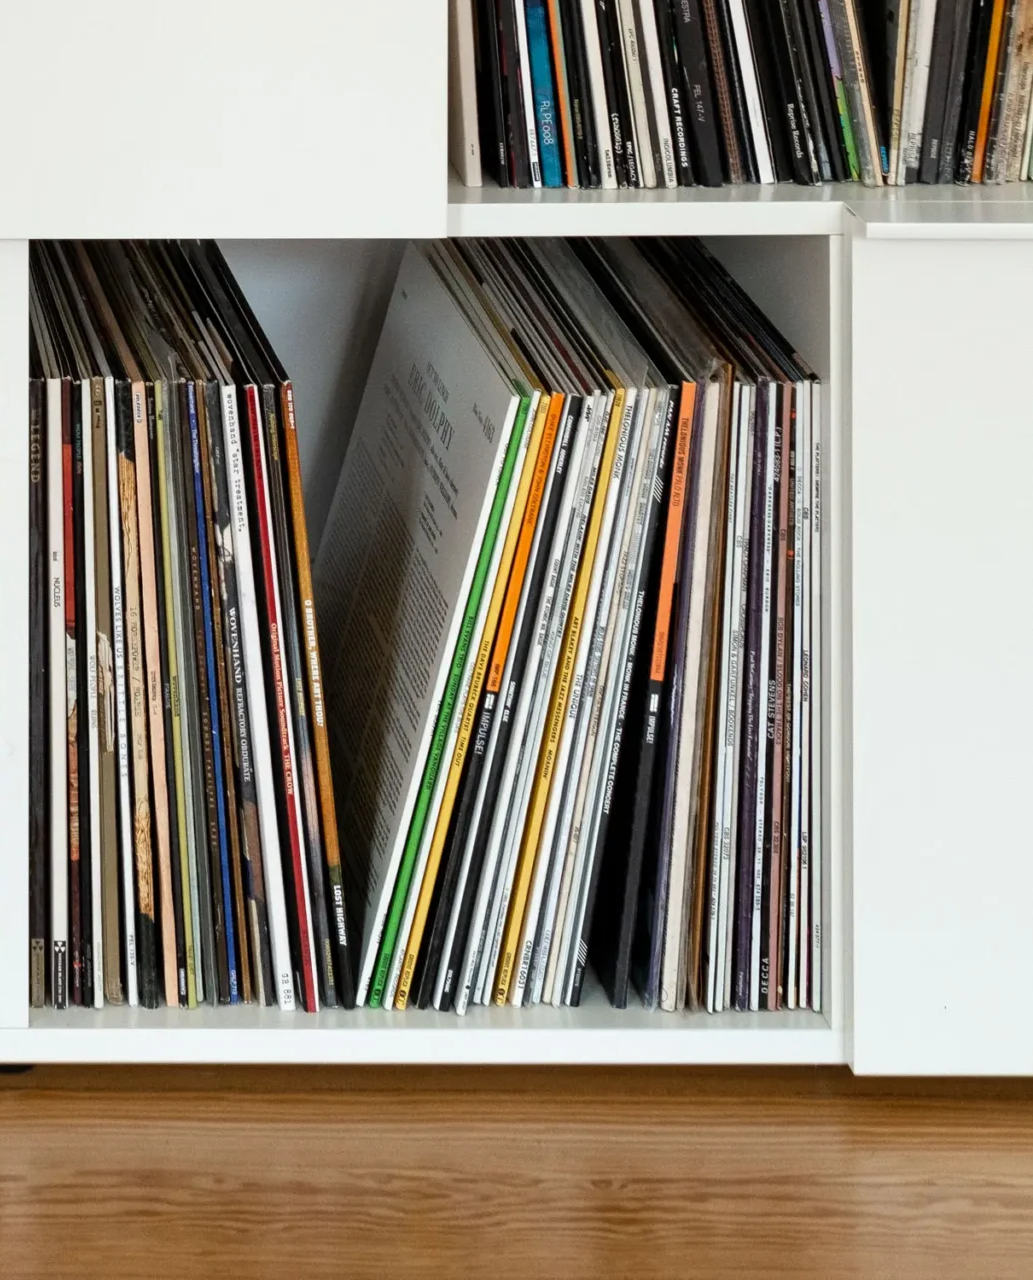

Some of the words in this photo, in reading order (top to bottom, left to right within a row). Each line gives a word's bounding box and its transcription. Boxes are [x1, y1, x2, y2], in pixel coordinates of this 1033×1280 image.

[671, 88, 681, 113] CRAFT
[675, 116, 688, 167] RECORDINGS
[663, 138, 674, 183] INO/COLUMBIA
[227, 394, 238, 444] wovenhand
[678, 418, 689, 454] THELONIOUS
[31, 425, 40, 483] LEGEND
[675, 457, 685, 474] MONK
[674, 475, 683, 490] PALO
[672, 492, 681, 506] ALTO
[631, 591, 644, 634] THELONIOUS
[304, 608, 316, 650] BROTHER,
[628, 635, 638, 655] MONK
[229, 608, 243, 683] WOVENHAND
[236, 688, 247, 737] REFRACTORY
[309, 652, 319, 681] WHERE
[624, 662, 633, 682] MONK
[312, 683, 321, 697] ART
[618, 692, 629, 719] FRANCE
[314, 700, 324, 726] THOU?
[474, 712, 491, 754] IMPULSE!
[614, 728, 623, 741] THE
[608, 743, 621, 779] COMPLETE
[603, 780, 615, 813] CONCERT
[333, 885, 343, 905] LOST
[335, 908, 347, 946] HIGHWAY
